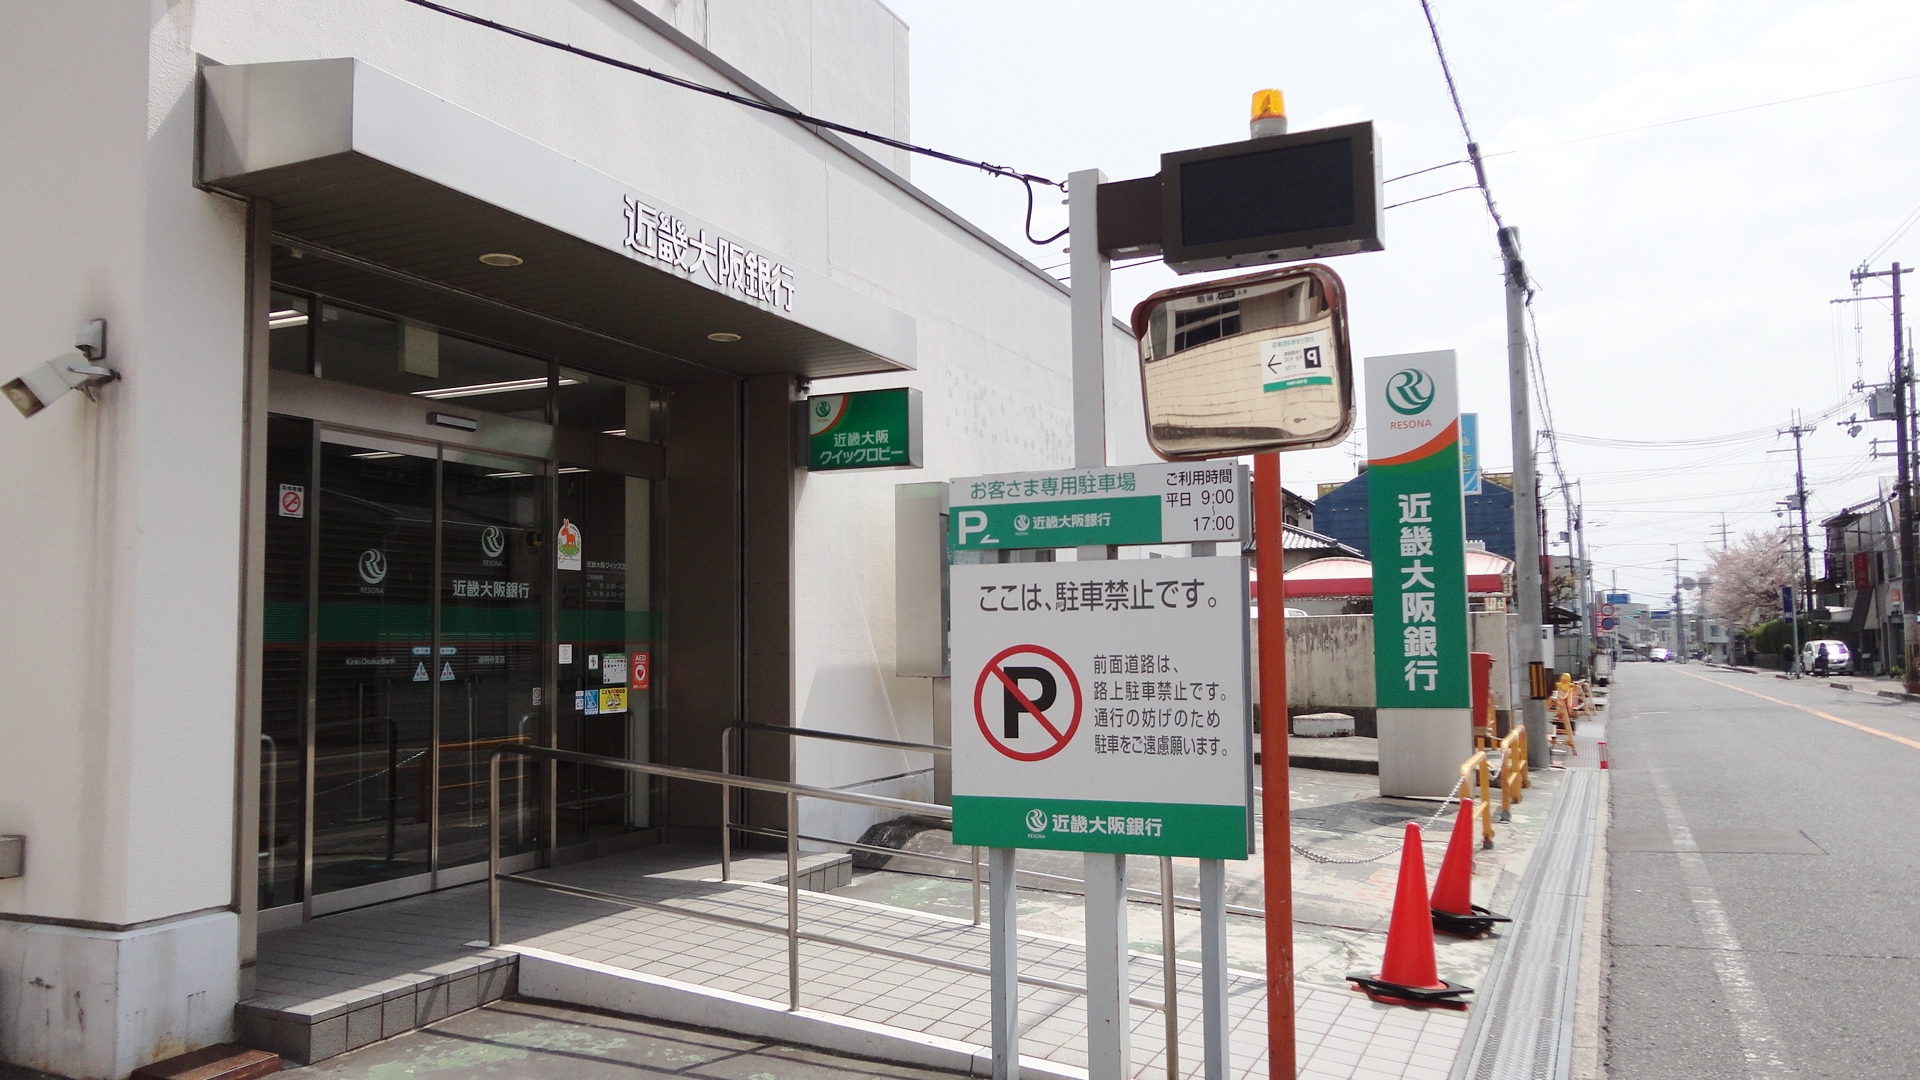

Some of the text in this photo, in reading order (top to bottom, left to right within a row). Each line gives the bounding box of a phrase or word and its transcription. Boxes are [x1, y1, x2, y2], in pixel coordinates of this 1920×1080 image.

[624, 194, 795, 313] 近畿大阪銀行
[1390, 419, 1433, 430] RESONA
[833, 430, 889, 448] 近畿大阪
[819, 446, 904, 466] クイックロビー
[970, 472, 1136, 500] お客さま専用駐車場
[1166, 469, 1233, 486] ご利用時間
[1166, 489, 1235, 507] 平日 9:00
[1032, 512, 1111, 530] 近畿大阪銀行
[1193, 515, 1235, 532] 17:00
[452, 579, 530, 599] 近畿大阪銀行
[980, 578, 1217, 613] ここは、駐車禁止です。
[1398, 492, 1439, 692] 近畿大阪銀行
[1093, 654, 1179, 675] 前面道路は、
[1093, 681, 1227, 702] 路上駐車禁止です。
[1094, 707, 1221, 729] 通行の妨げのため
[1094, 734, 1228, 757] 駐車をご遠慮願います。
[1052, 813, 1163, 837] 近畿大阪銀行
